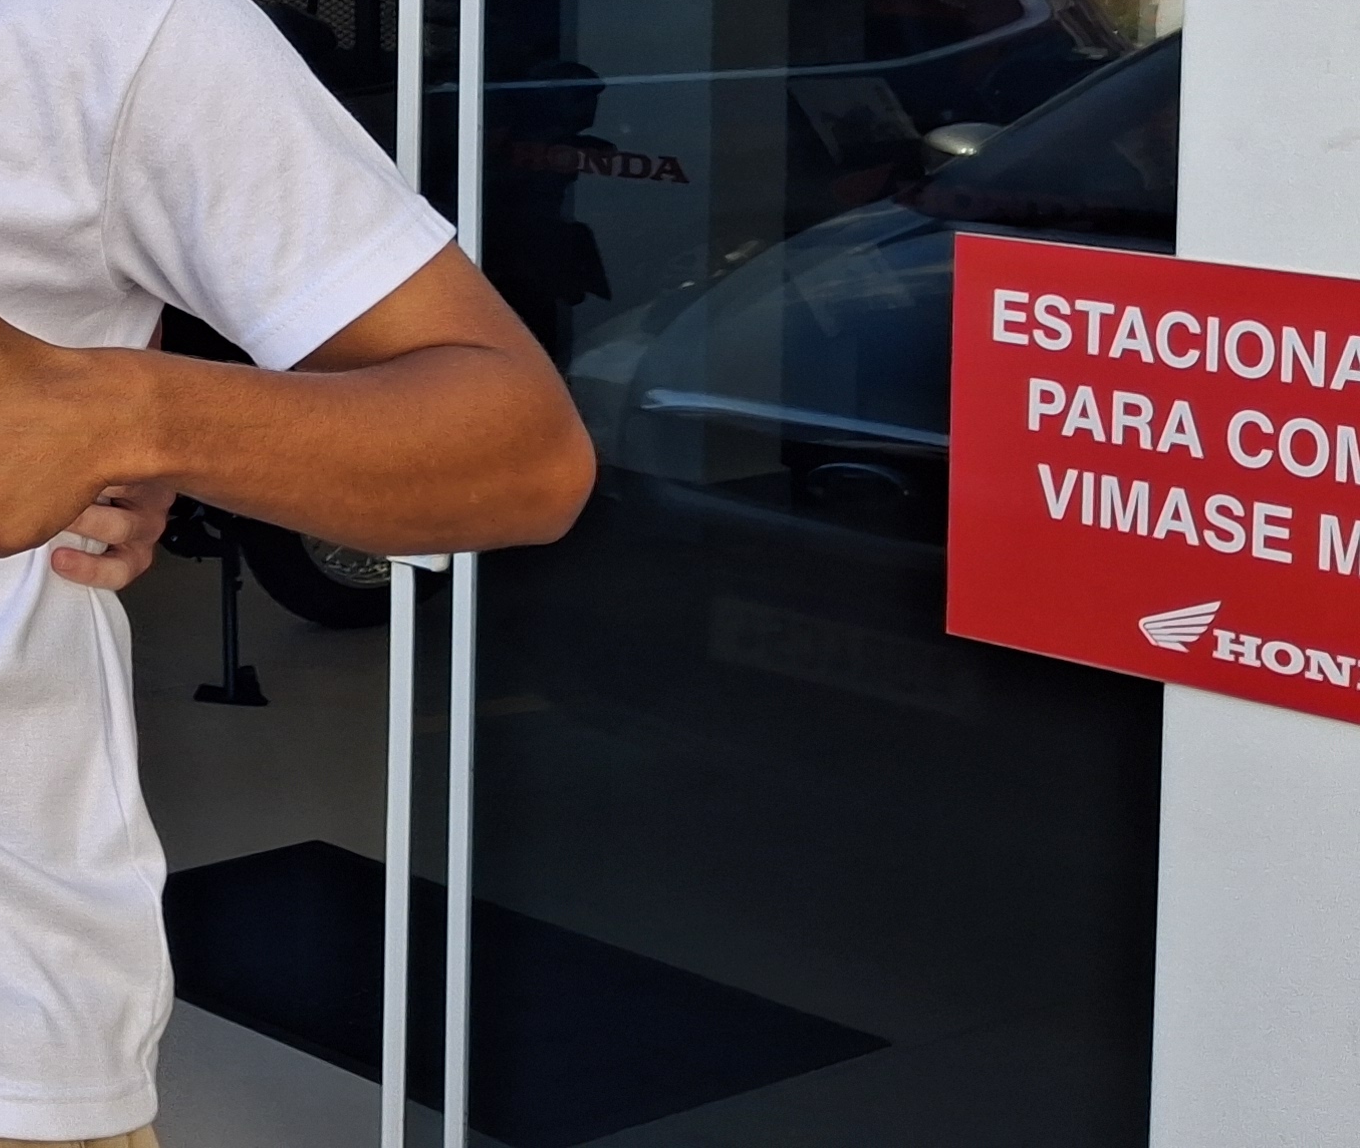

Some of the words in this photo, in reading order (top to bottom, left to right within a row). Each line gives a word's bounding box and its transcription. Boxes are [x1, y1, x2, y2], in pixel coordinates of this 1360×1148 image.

[992, 287, 1360, 392] ESTACIONA
[1027, 376, 1204, 460] PARA
[1037, 463, 1292, 564] VIMASE
[1212, 628, 1360, 690] HON
